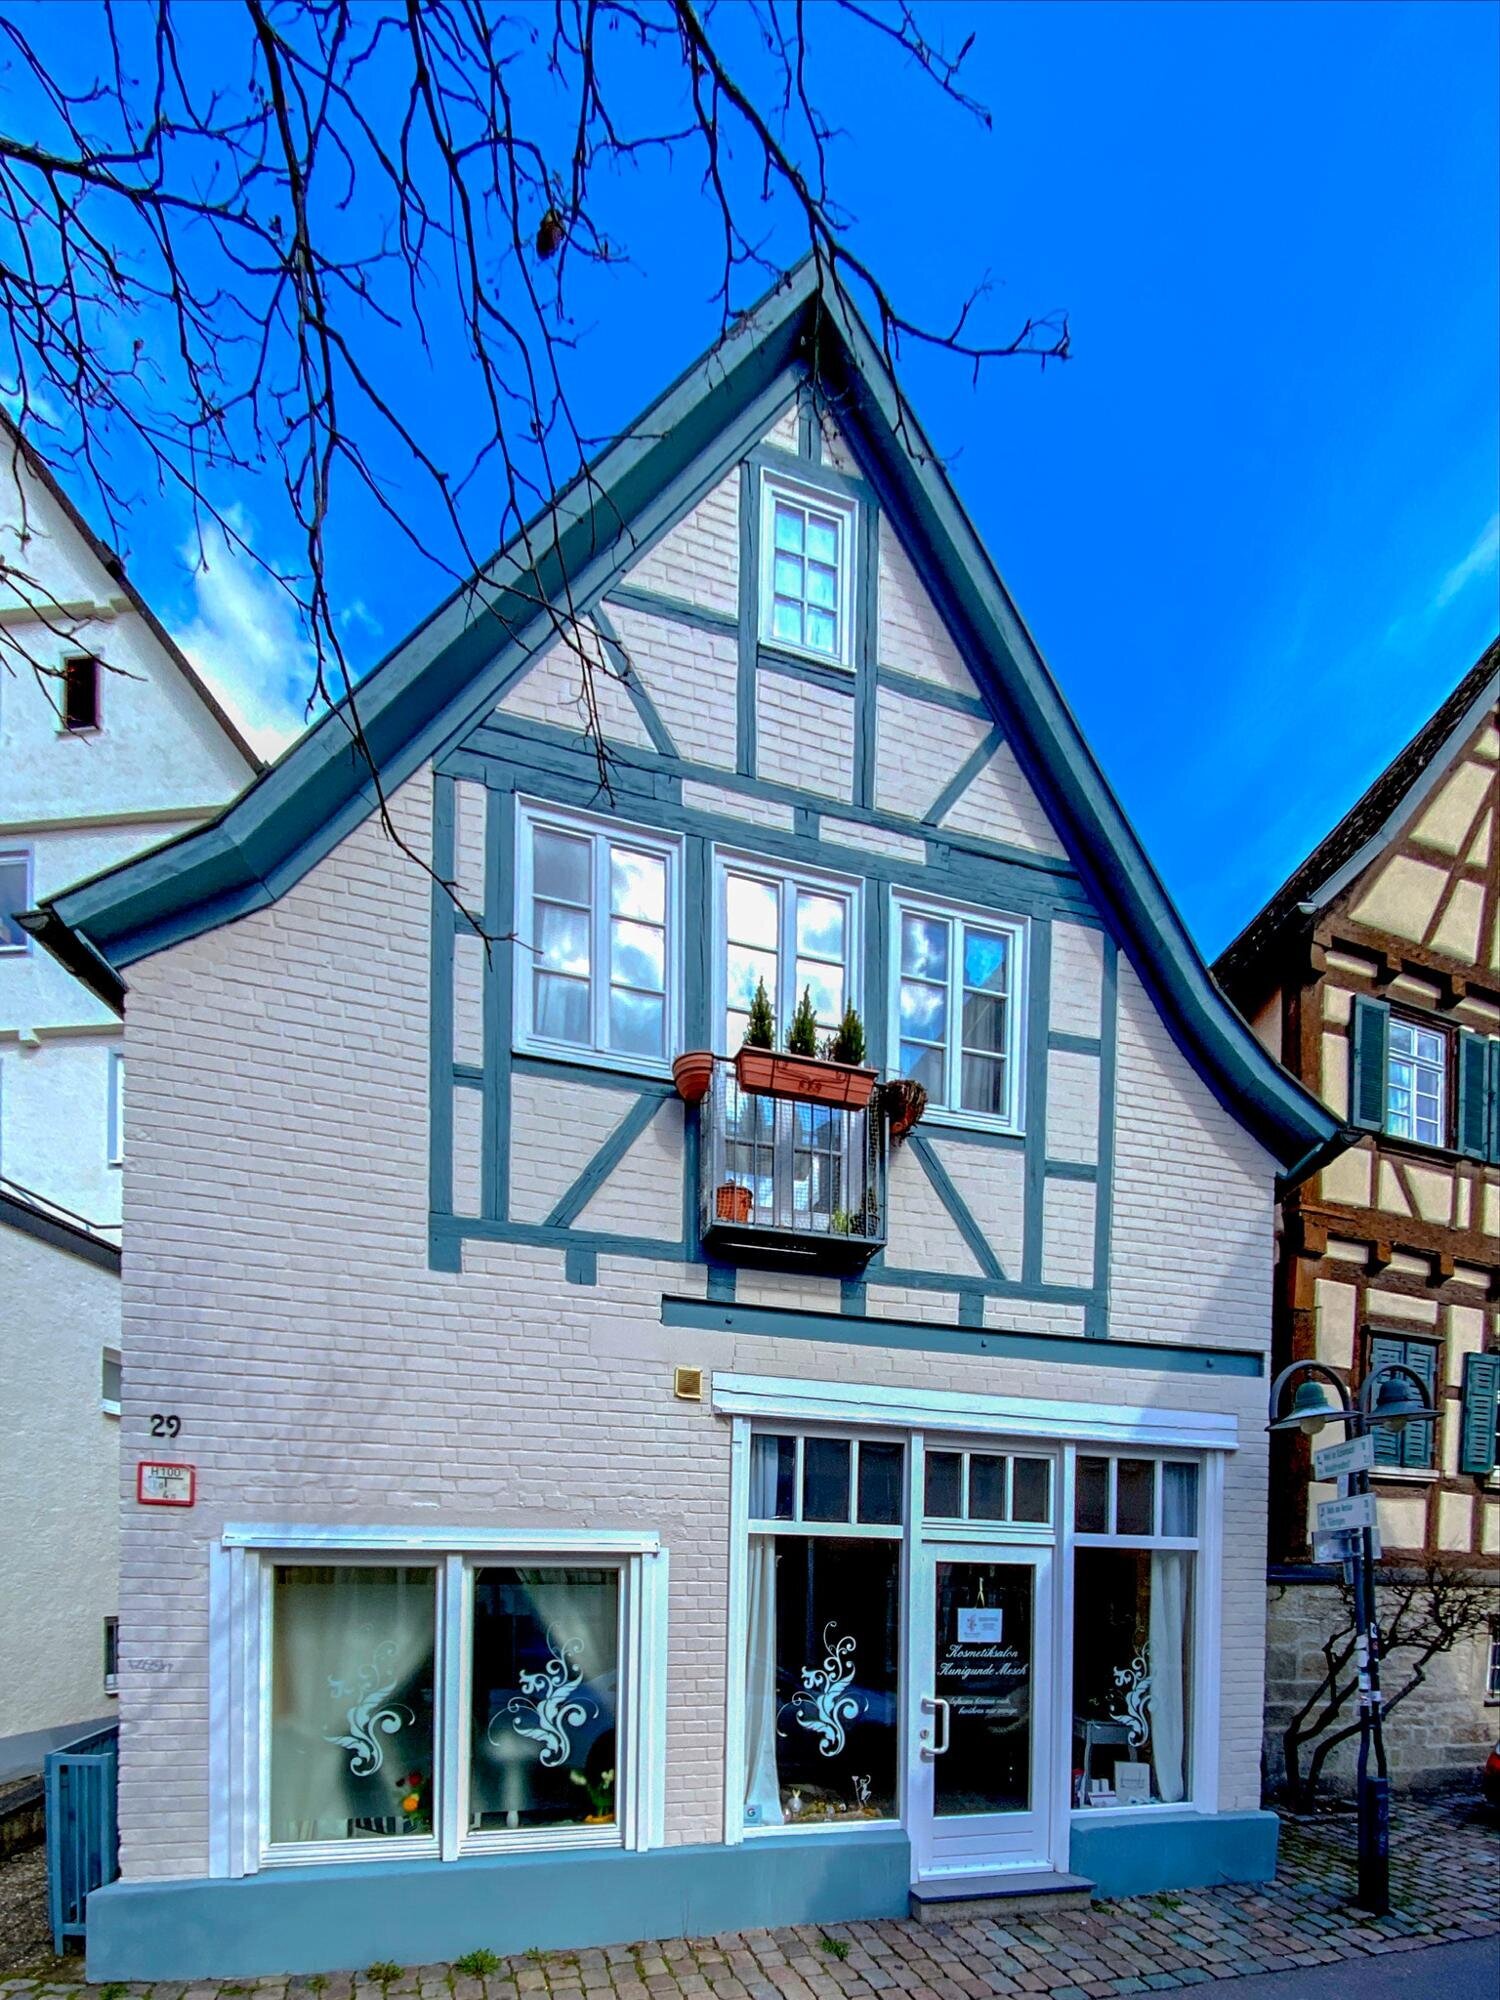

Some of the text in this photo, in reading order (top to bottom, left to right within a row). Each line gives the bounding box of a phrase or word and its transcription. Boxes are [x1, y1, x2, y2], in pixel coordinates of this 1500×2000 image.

[150, 1413, 181, 1438] 29
[946, 1644, 1018, 1658] Kosmetiksalon
[937, 1662, 995, 1680] Kunigunde
